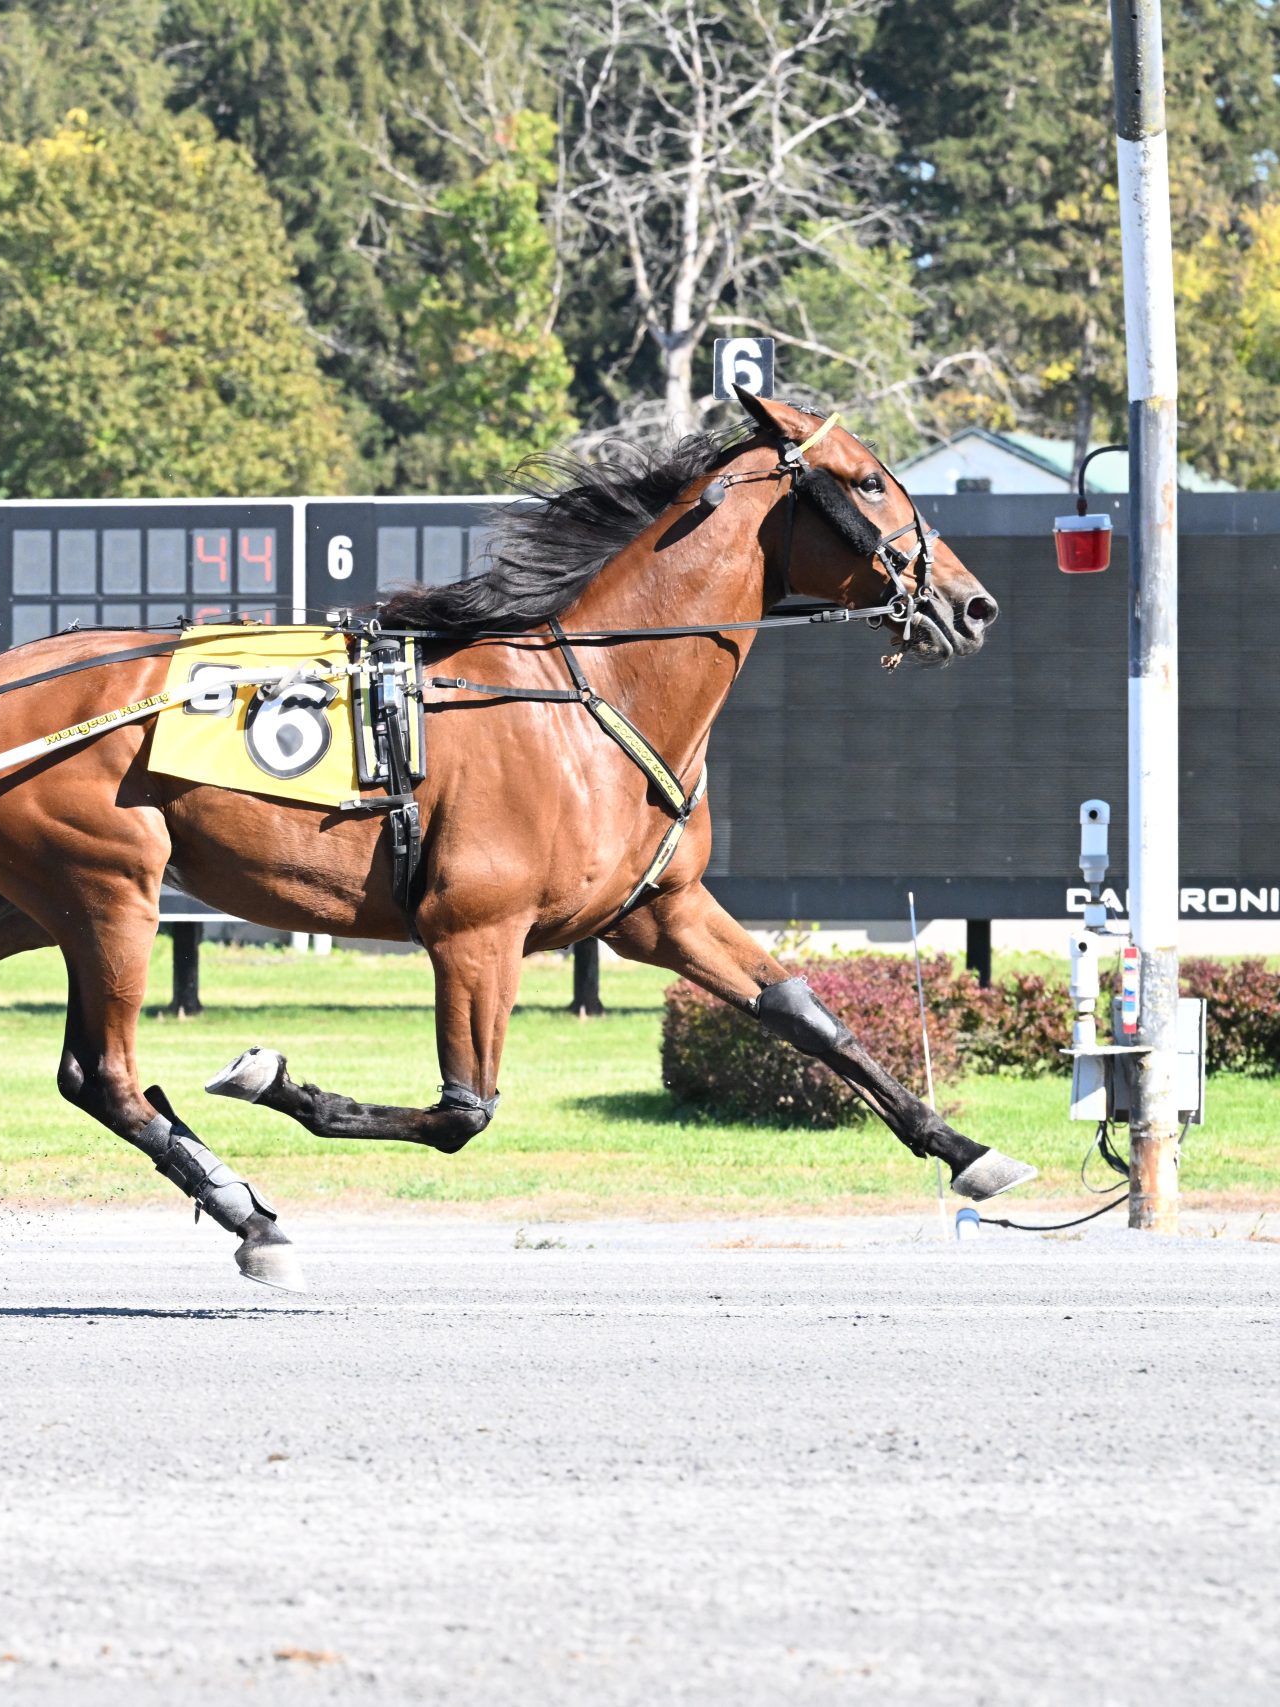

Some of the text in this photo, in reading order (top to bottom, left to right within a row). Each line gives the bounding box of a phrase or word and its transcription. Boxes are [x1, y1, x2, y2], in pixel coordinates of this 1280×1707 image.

[721, 338, 764, 399] 6
[327, 535, 354, 580] 6
[44, 691, 170, 745] Mongeon Racing
[247, 679, 334, 777] 6
